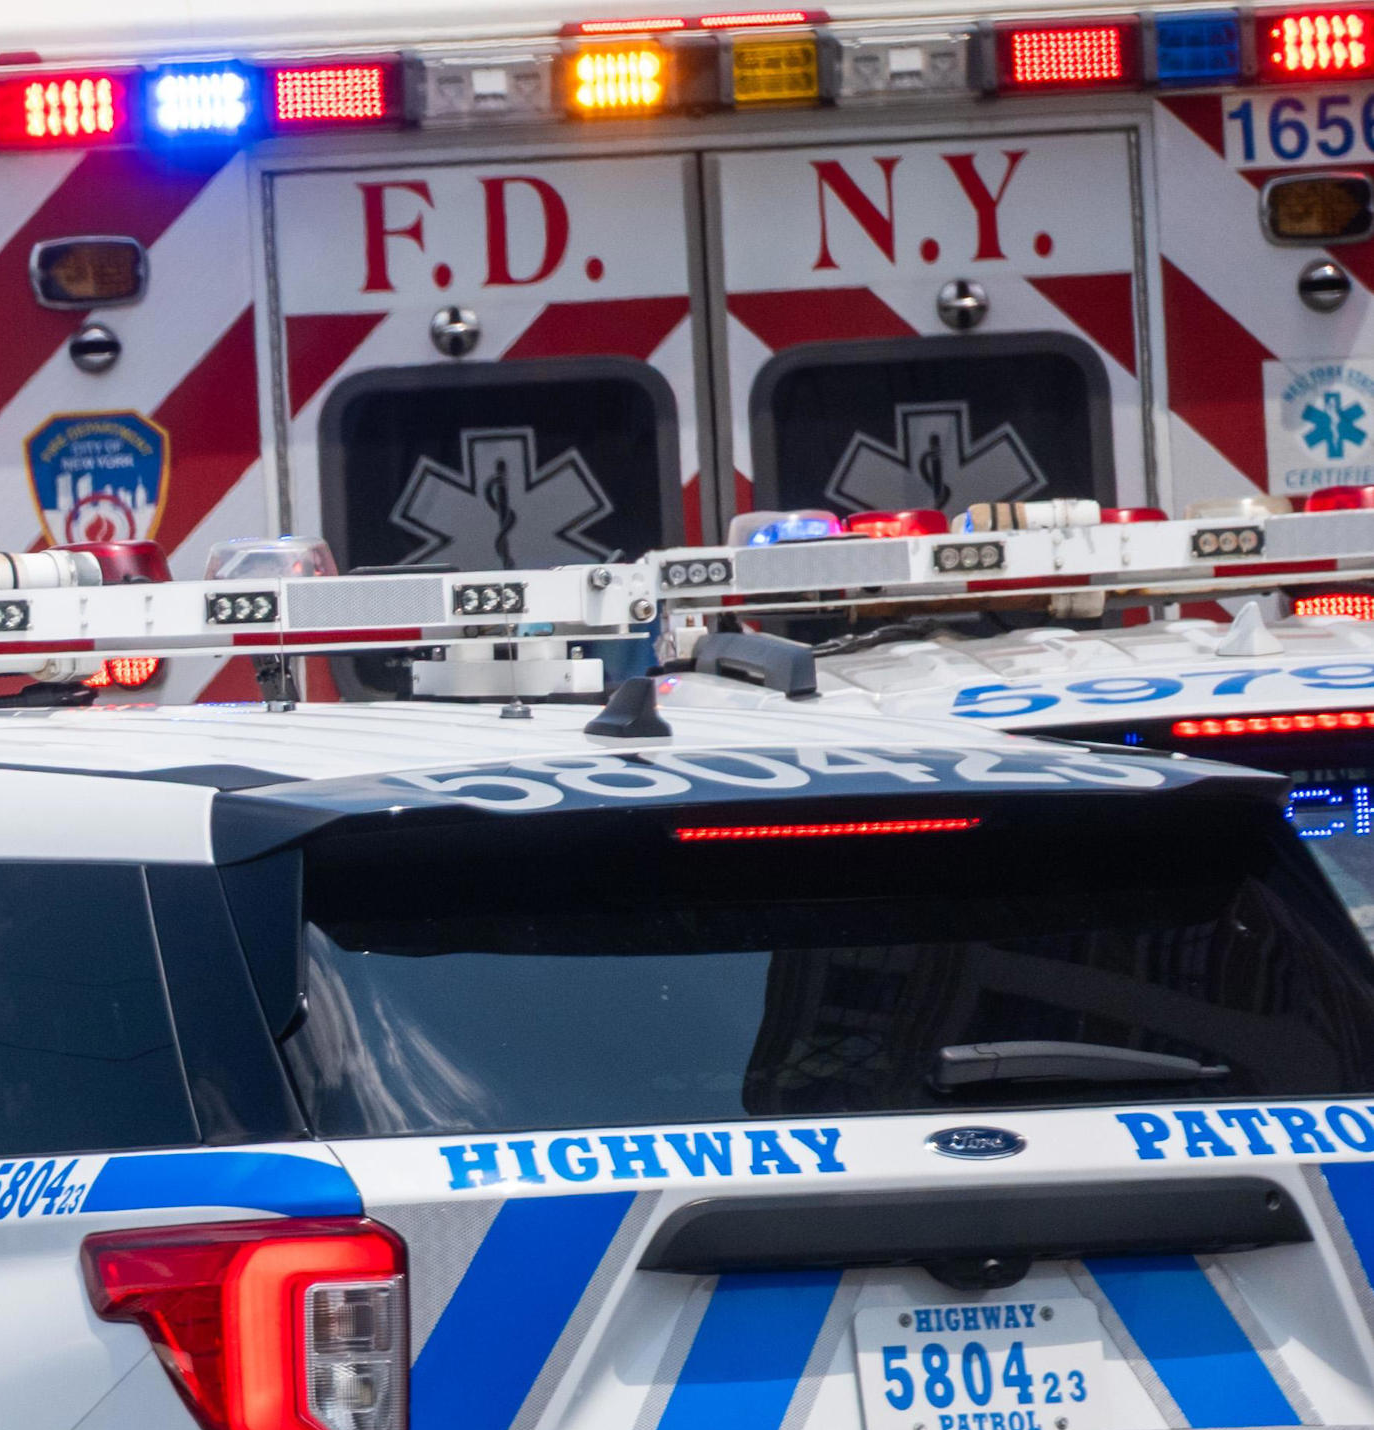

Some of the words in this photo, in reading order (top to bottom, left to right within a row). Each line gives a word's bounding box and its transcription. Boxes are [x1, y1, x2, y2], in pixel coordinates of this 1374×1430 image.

[358, 176, 606, 293] F.D.
[811, 151, 1056, 273] N.Y.
[439, 1128, 846, 1190] HIGHWAY
[1115, 1105, 1374, 1160] PATRO
[914, 1304, 1037, 1333] HIGHWAY
